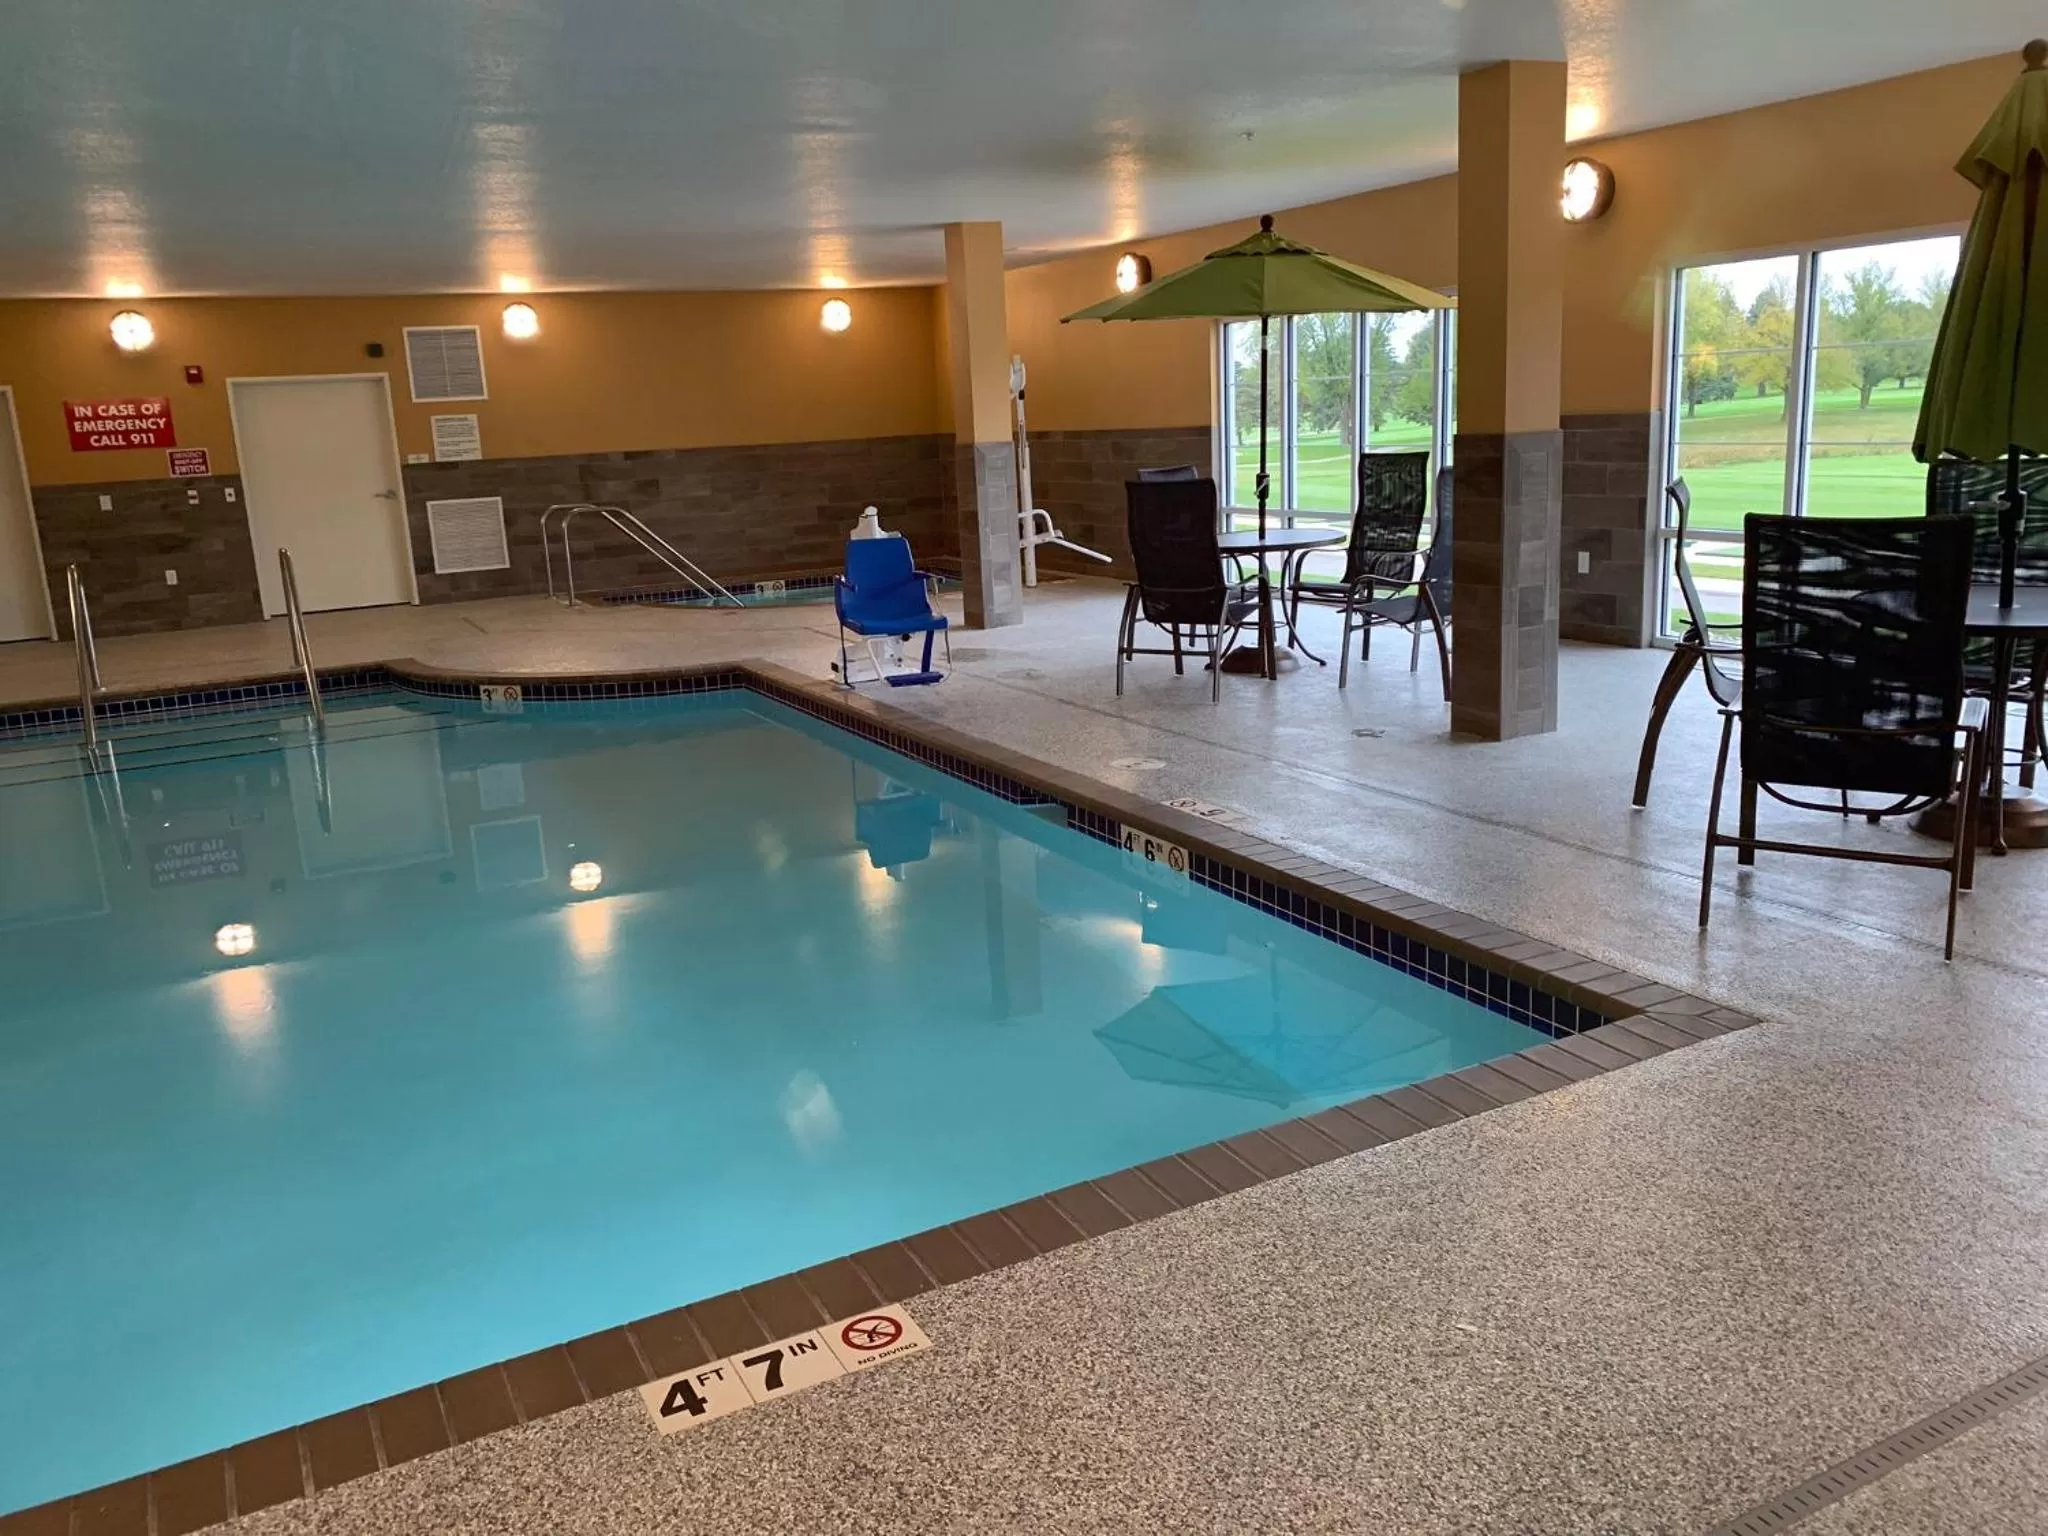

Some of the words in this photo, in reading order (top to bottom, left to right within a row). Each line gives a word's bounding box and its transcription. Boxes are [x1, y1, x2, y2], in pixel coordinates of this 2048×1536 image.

[74, 406, 92, 417] IN
[98, 404, 136, 416] CASE
[141, 403, 161, 415] OF
[74, 418, 166, 432] EMERGENCY
[90, 434, 127, 447] CALL
[130, 433, 155, 445] 911
[174, 464, 206, 474] SWITCH
[1123, 831, 1134, 852] 4
[1145, 839, 1156, 862] 6
[858, 1356, 876, 1365] NO
[879, 1343, 918, 1358] DIVING
[659, 1379, 708, 1418] 4
[696, 1367, 724, 1387] FT
[743, 1349, 784, 1391] 7
[789, 1339, 818, 1357] IN
